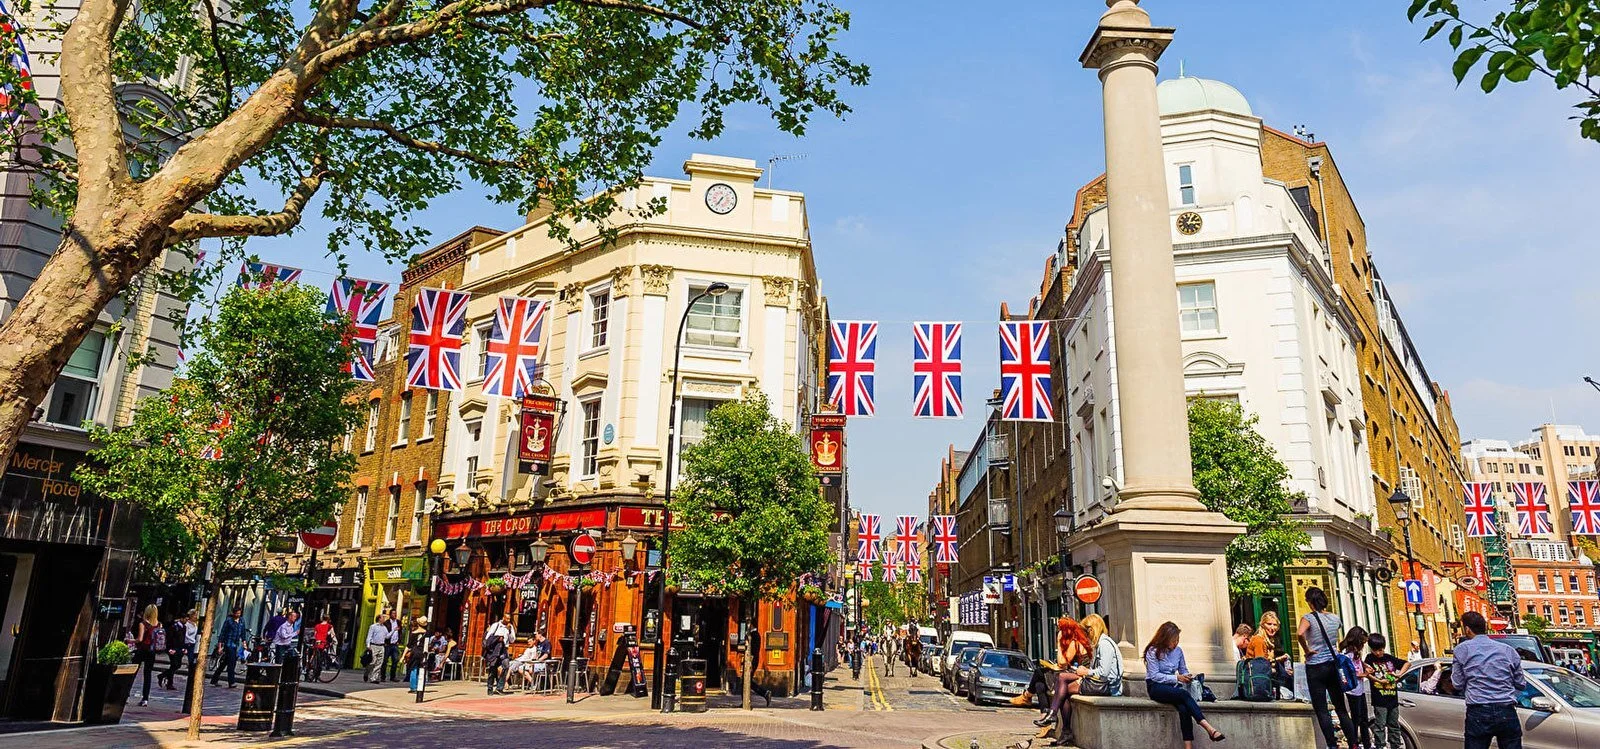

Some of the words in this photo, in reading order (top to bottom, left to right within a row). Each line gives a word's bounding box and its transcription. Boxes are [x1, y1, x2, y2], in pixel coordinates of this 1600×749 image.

[12, 452, 65, 473] Mercer
[41, 479, 81, 497] Hotel
[484, 520, 502, 533] THE
[505, 515, 541, 532] CROWN
[641, 509, 684, 528] THE
